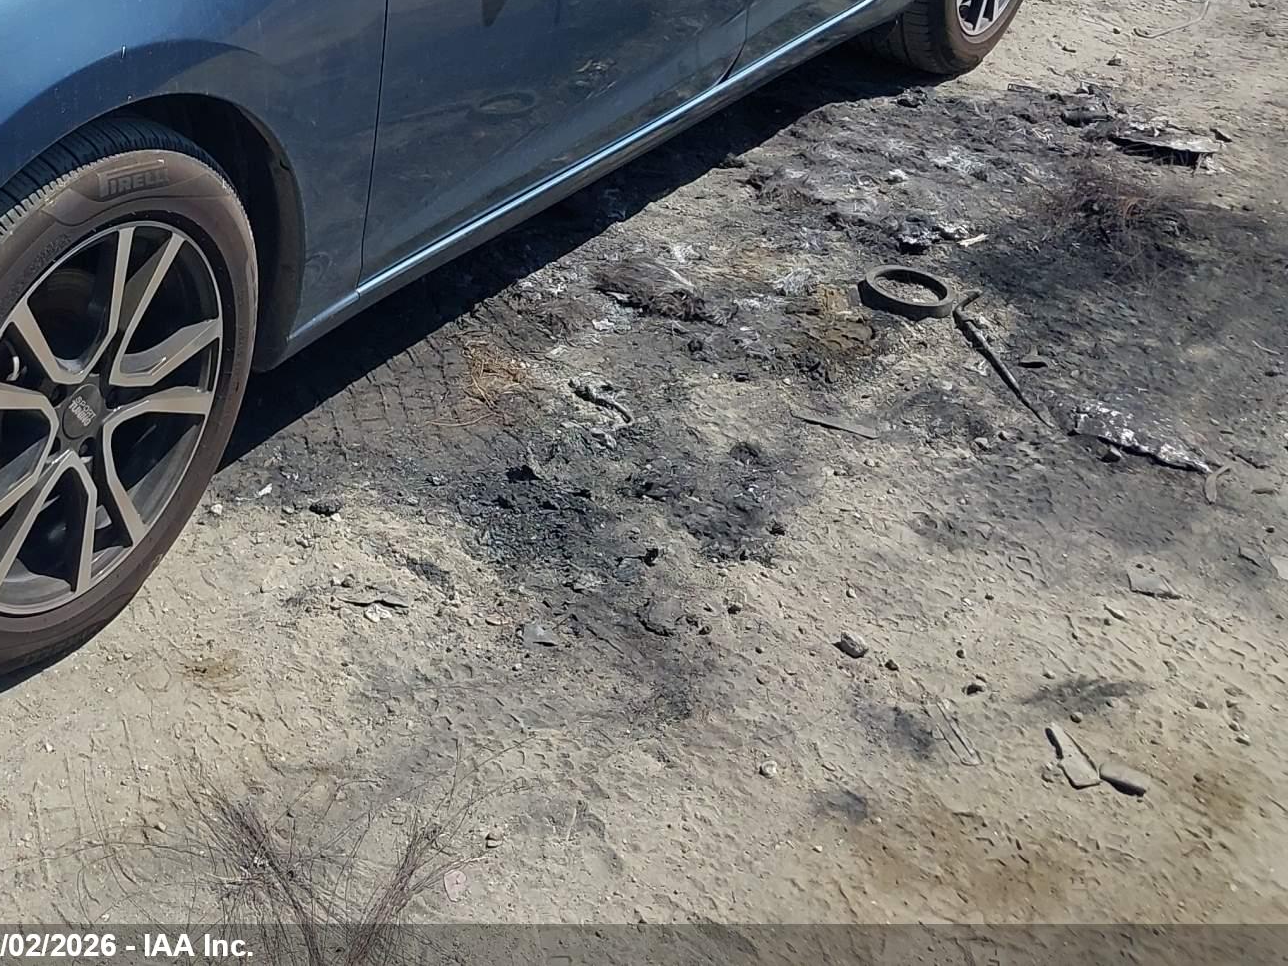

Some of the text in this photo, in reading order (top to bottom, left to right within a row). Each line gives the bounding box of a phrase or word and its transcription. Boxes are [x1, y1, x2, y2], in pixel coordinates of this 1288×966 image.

[97, 160, 169, 199] PIRELLI
[68, 400, 92, 426] TUNING
[75, 396, 97, 419] SPORT
